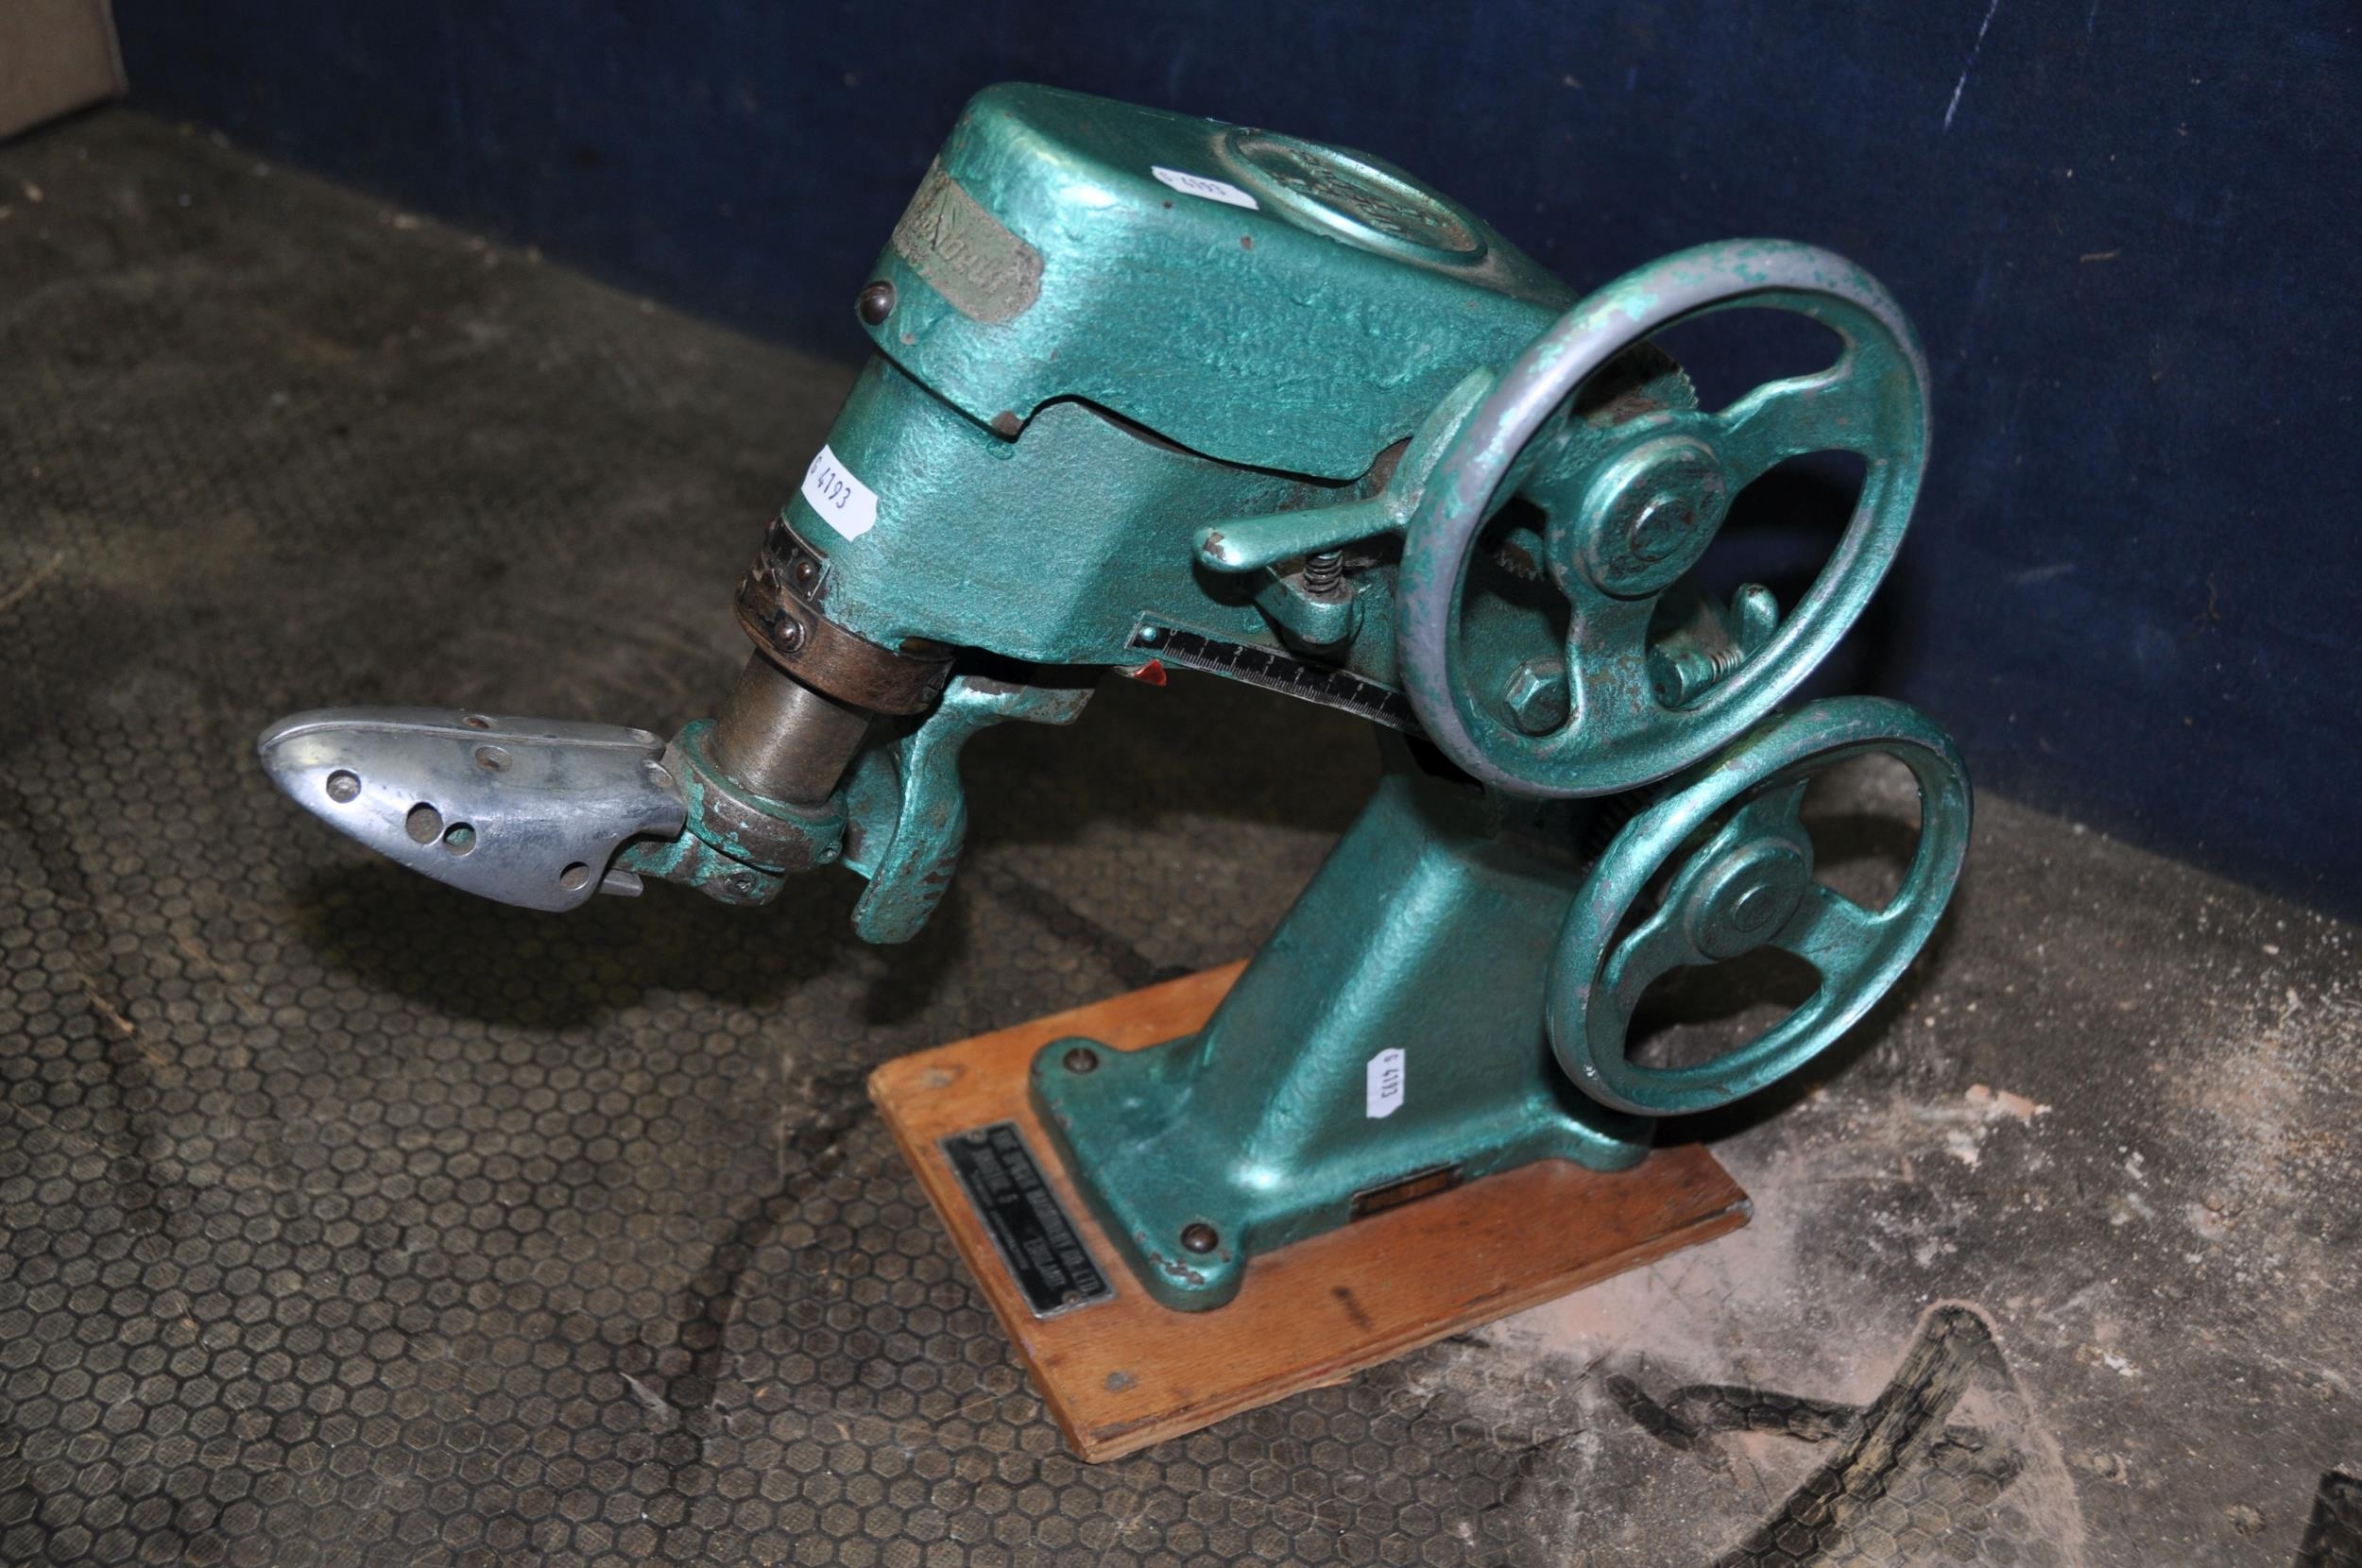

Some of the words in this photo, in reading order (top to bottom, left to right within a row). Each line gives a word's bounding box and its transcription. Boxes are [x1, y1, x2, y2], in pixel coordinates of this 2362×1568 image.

[1180, 176, 1226, 196] 4193
[816, 467, 852, 509] 4193
[1233, 646, 1244, 656] 2
[1266, 655, 1276, 665] 3
[1380, 1067, 1399, 1099] 4193
